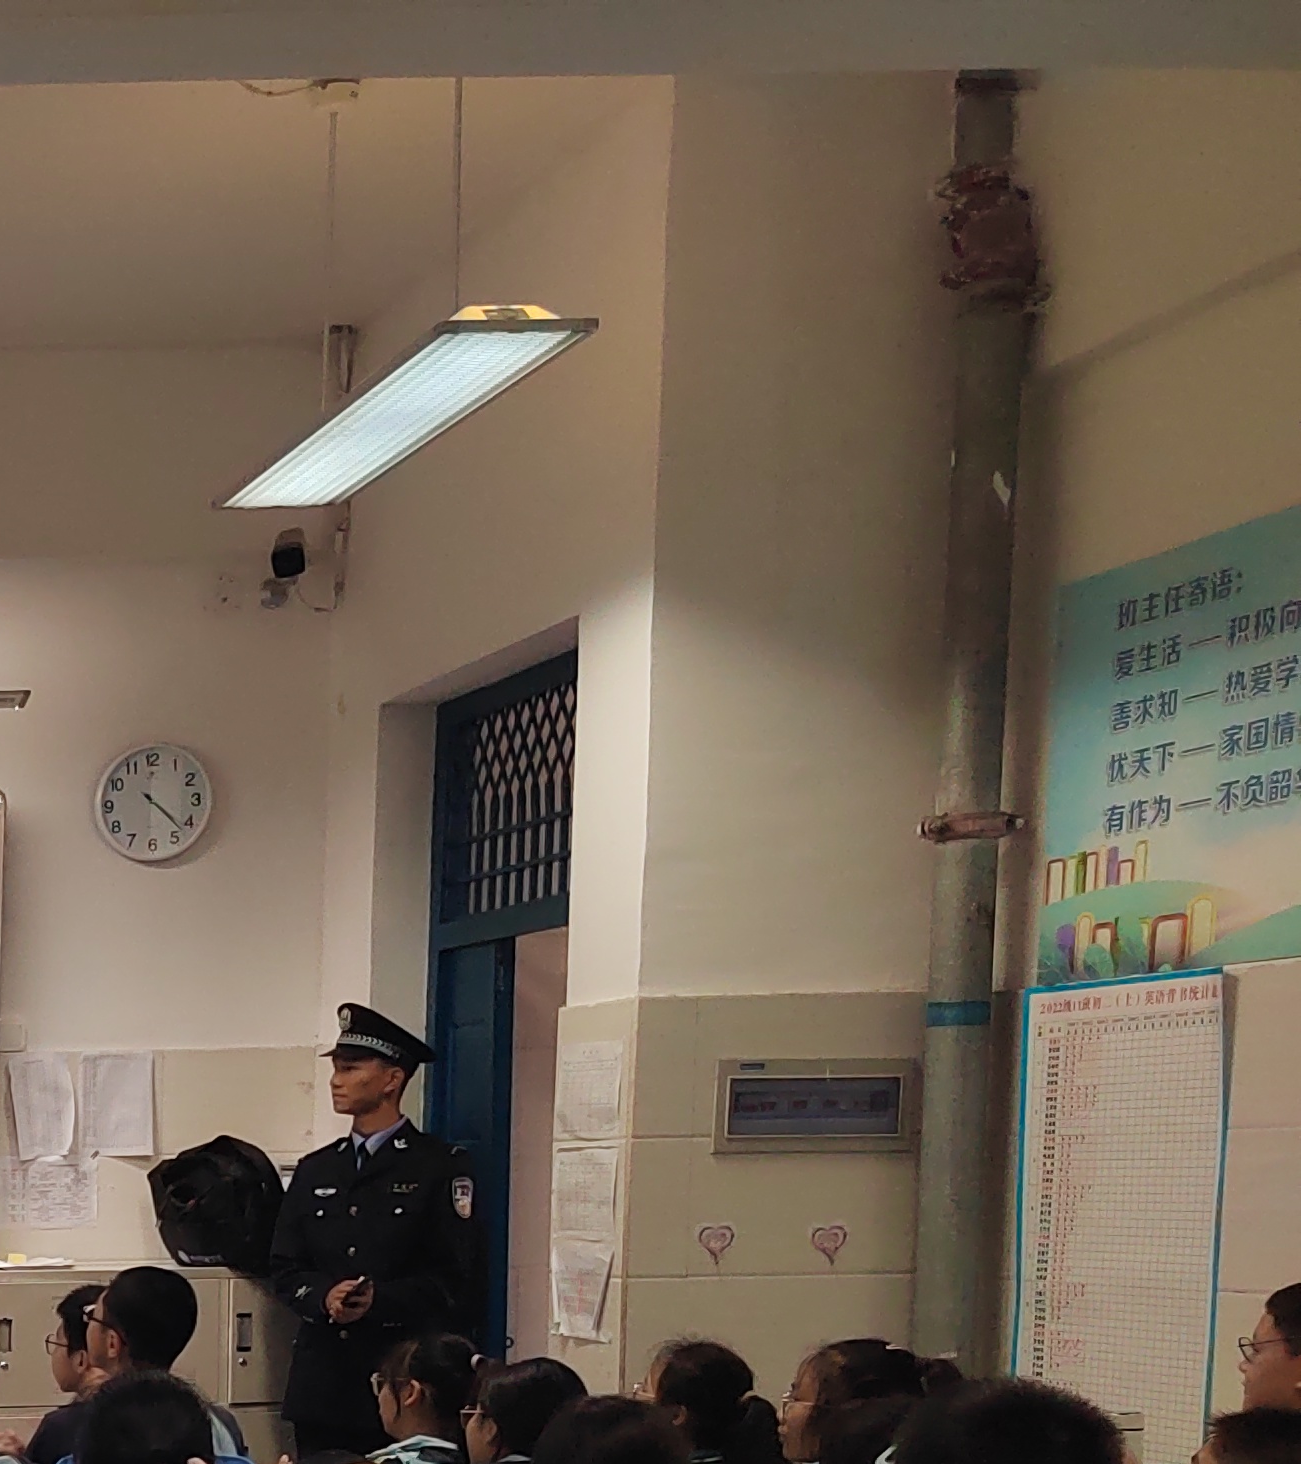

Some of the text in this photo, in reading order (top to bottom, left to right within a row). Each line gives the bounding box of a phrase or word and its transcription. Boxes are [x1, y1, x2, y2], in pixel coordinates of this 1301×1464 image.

[147, 753, 160, 767] 12
[173, 758, 178, 771] 1
[126, 761, 138, 775] 11
[111, 778, 124, 791] 10
[185, 773, 196, 786] 2
[104, 800, 114, 813] 9
[191, 793, 202, 807] 3
[111, 821, 121, 833] 8
[184, 815, 194, 828] 4
[126, 834, 137, 848] 7
[169, 831, 180, 845] 5
[148, 839, 157, 851] 6
